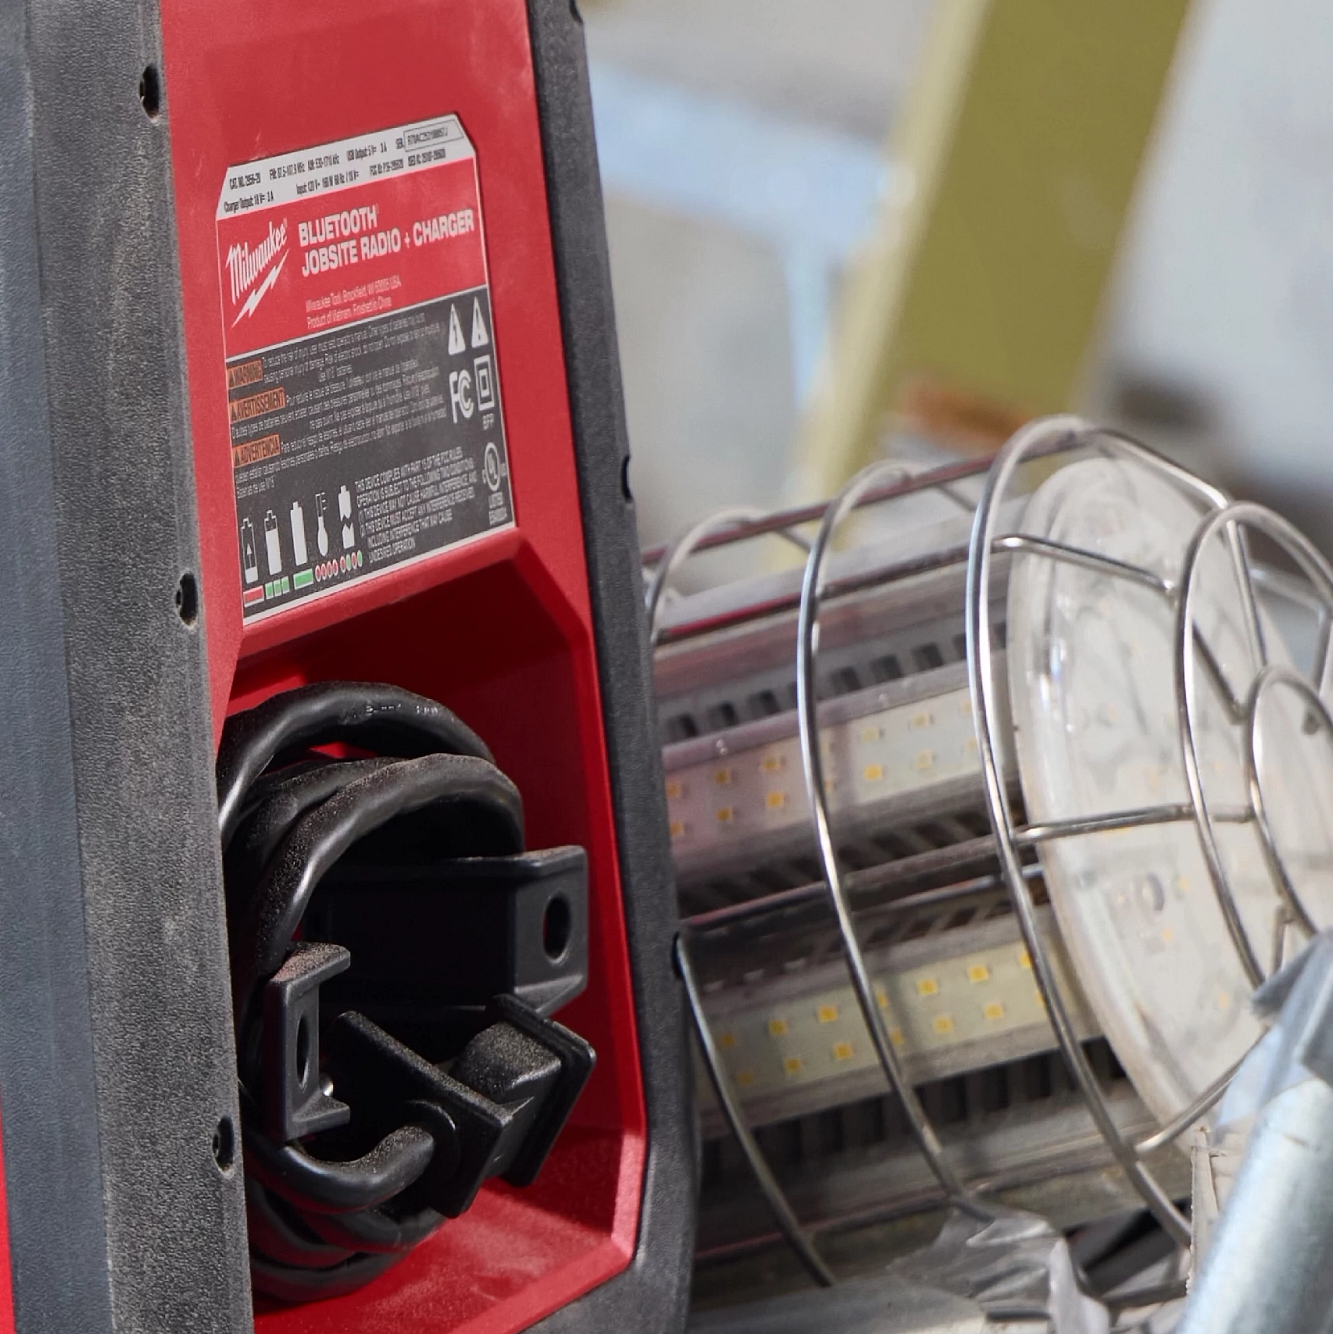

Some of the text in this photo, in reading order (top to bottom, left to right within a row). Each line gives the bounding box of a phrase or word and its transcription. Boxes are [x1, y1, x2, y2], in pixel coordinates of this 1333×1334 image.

[298, 203, 378, 247] BLUETOOTH
[300, 238, 358, 277] JOBSITE
[359, 226, 402, 261] RADIO
[411, 207, 474, 246] CHARGER
[225, 220, 287, 305] Milwaukee
[236, 388, 284, 420] AVERTISSEMENT
[240, 434, 279, 465] ADVERTENCIA
